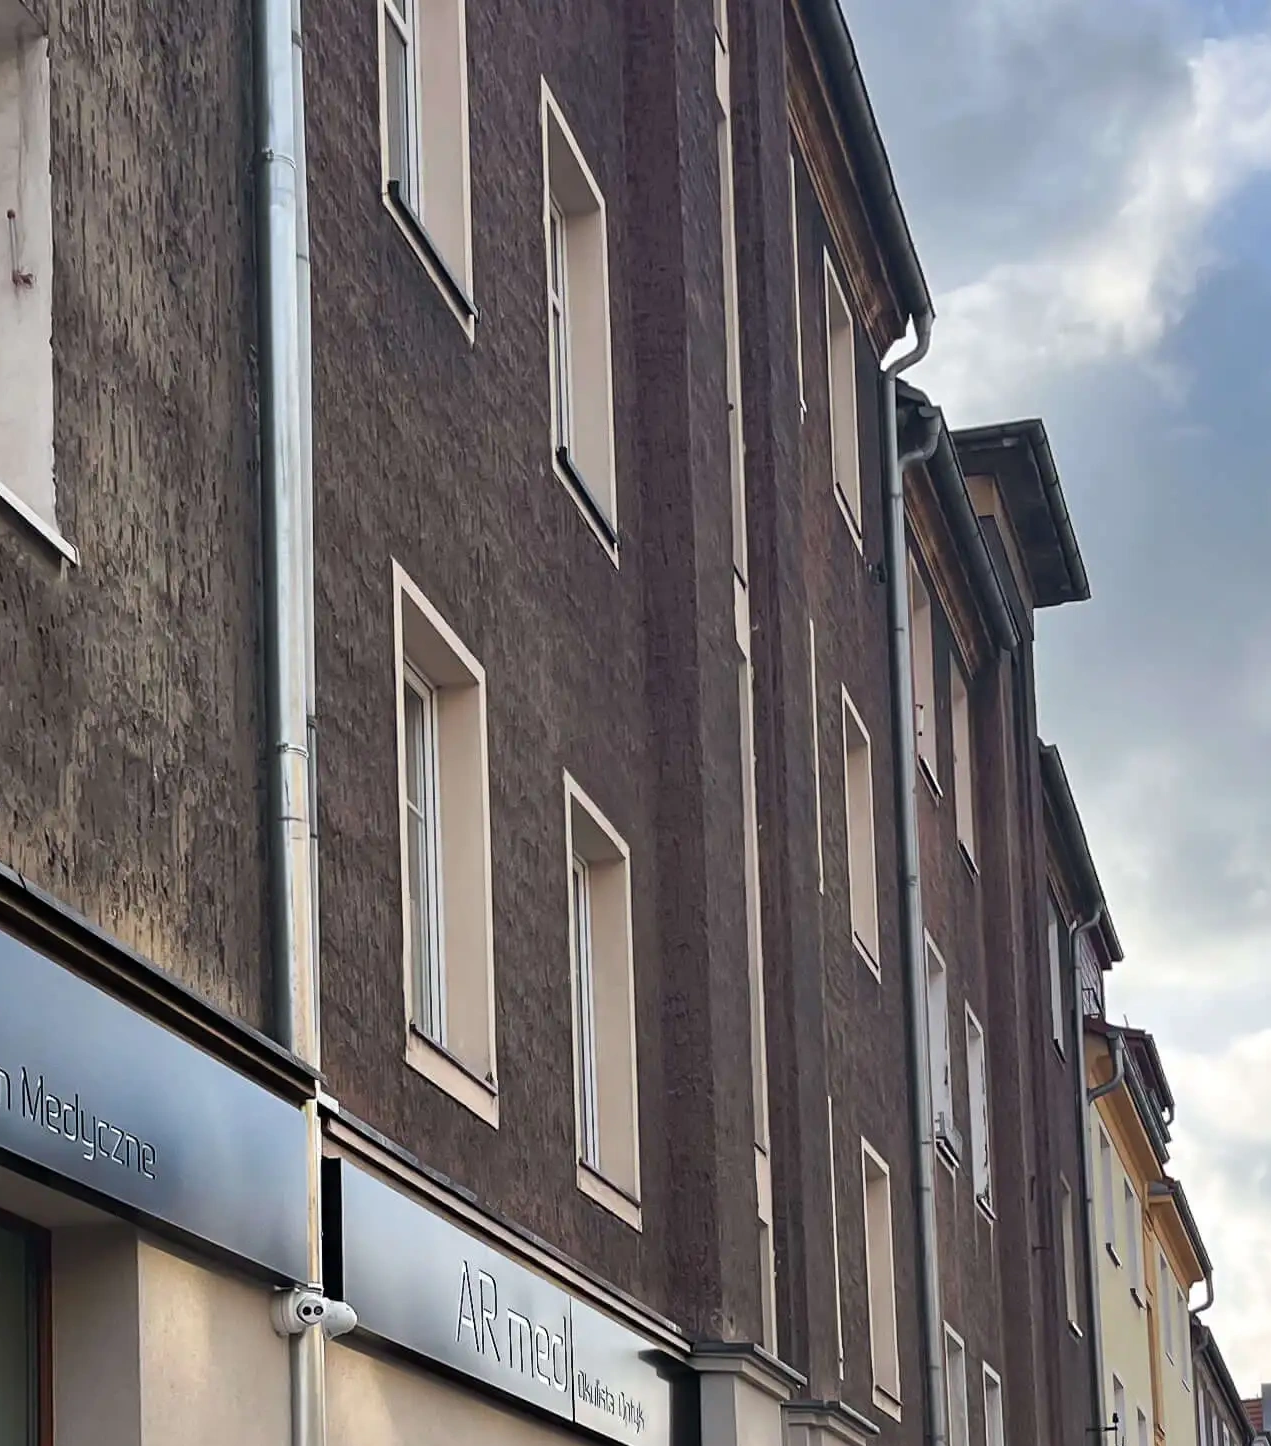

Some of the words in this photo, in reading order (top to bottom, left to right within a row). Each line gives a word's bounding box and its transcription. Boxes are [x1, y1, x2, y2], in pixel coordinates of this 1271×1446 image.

[21, 1065, 158, 1180] Medyczne
[455, 1260, 501, 1362] AR
[507, 1307, 569, 1393] med
